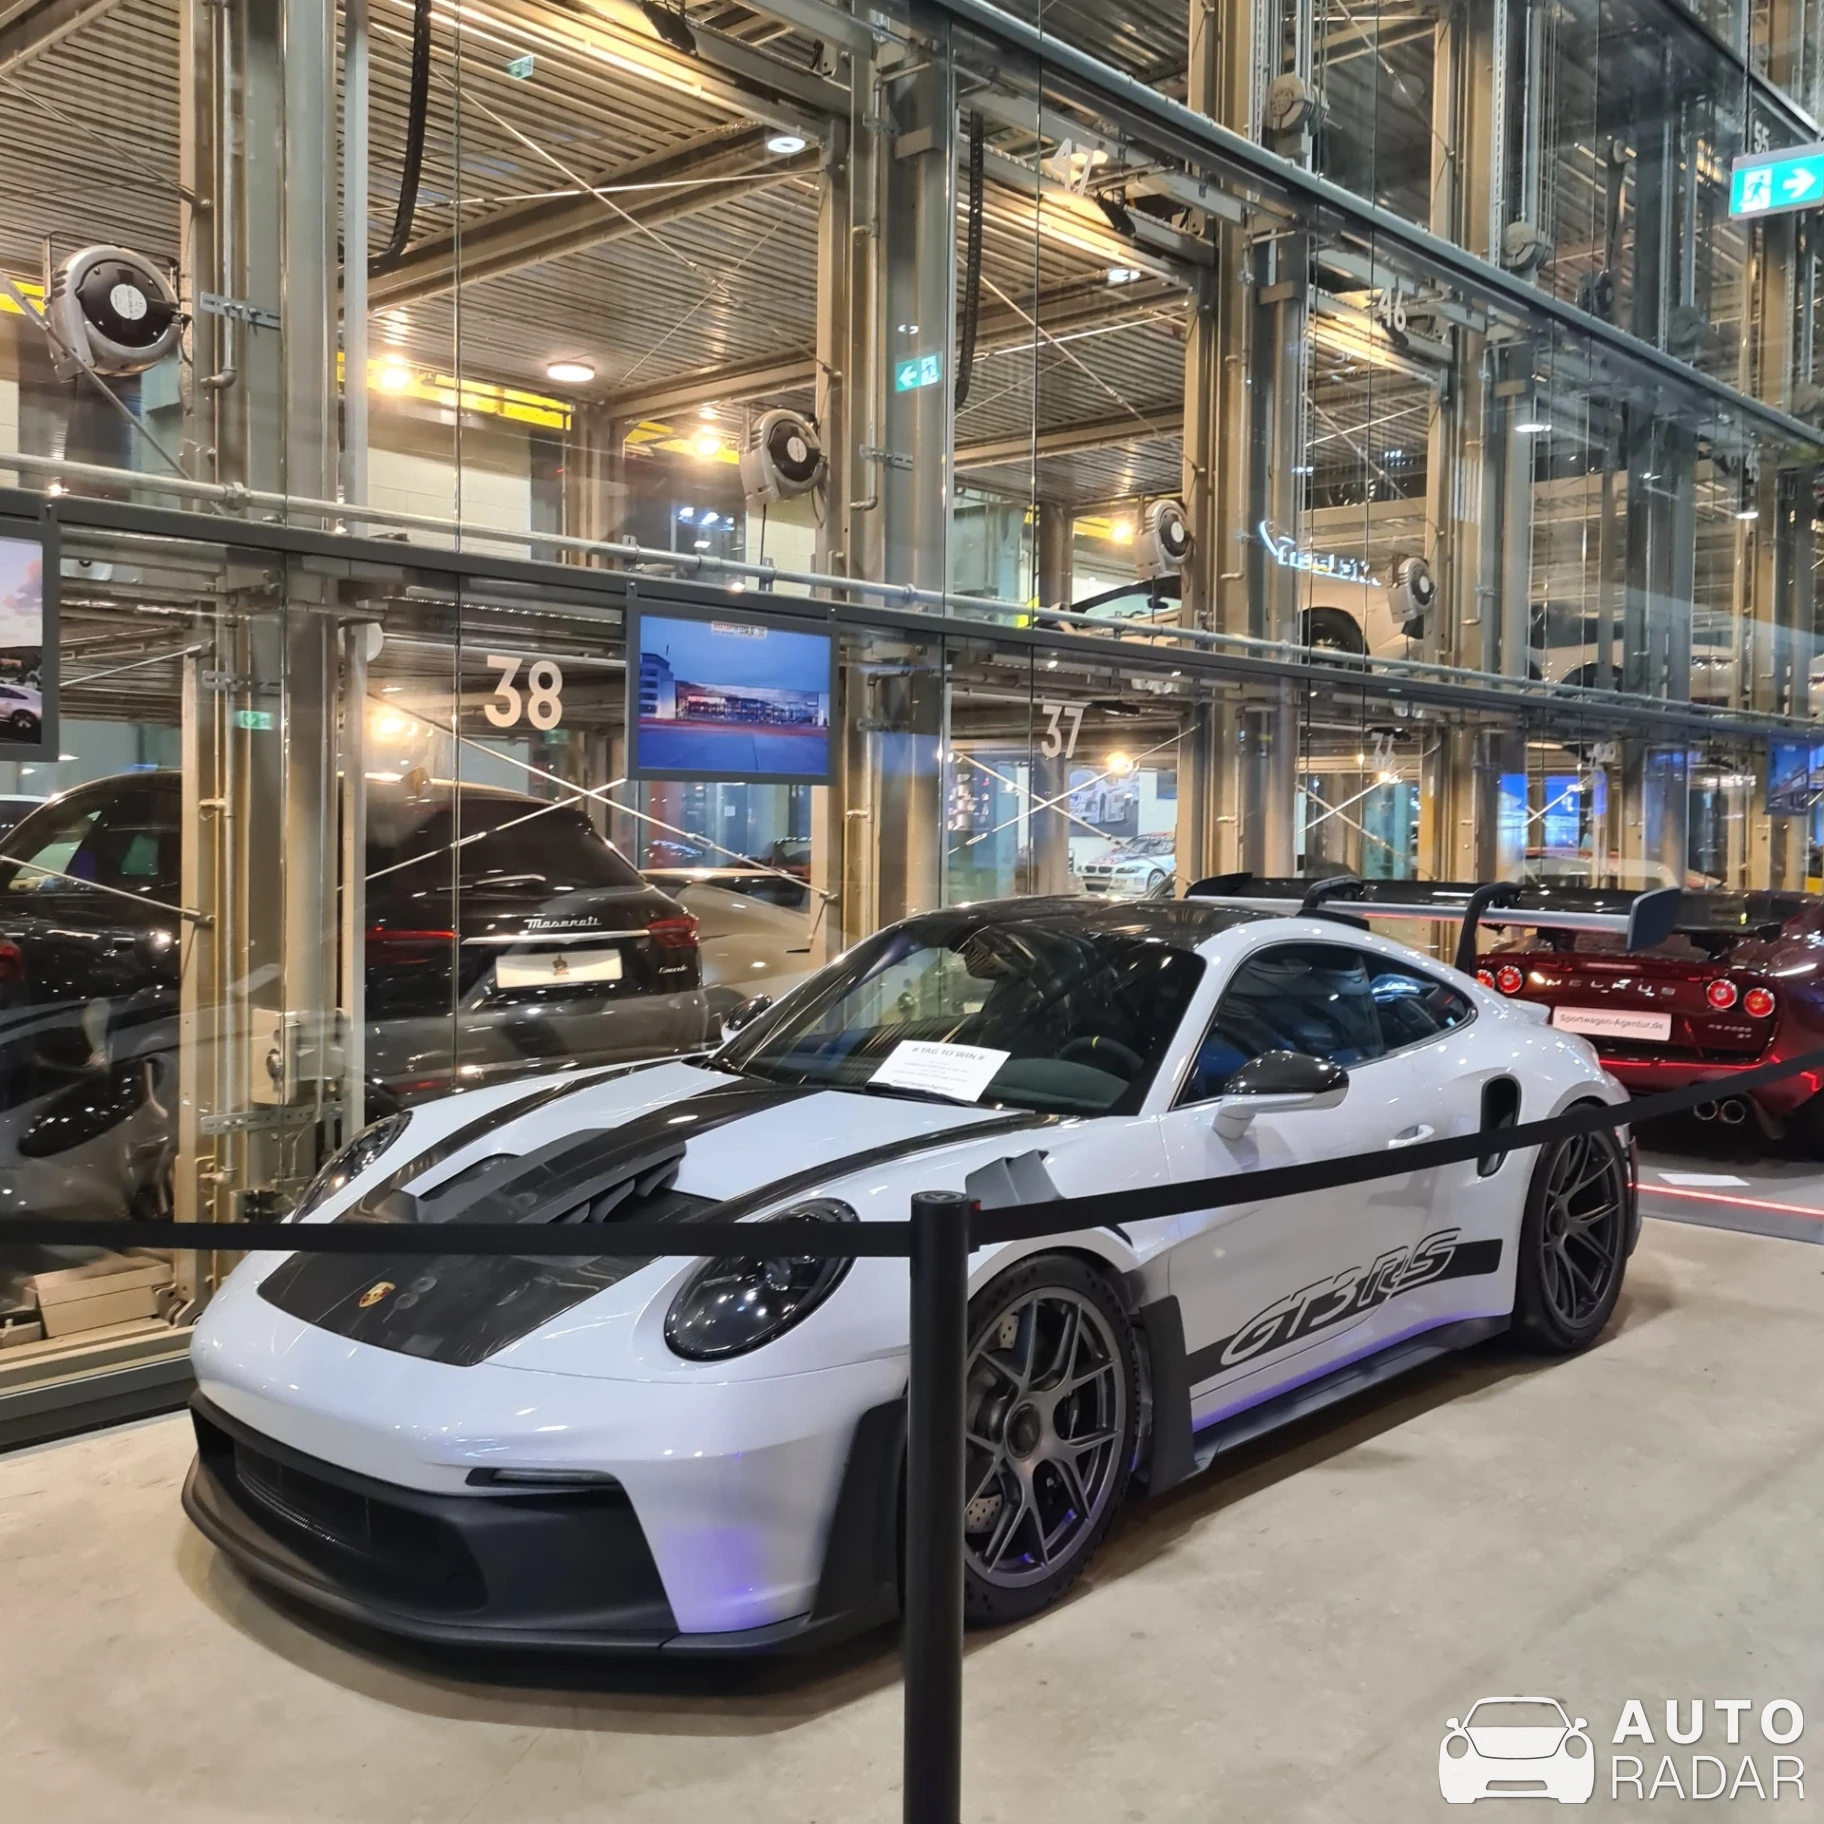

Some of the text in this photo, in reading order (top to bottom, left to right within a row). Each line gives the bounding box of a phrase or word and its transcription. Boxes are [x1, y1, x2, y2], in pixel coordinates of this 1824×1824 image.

[1051, 138, 1094, 197] 47
[1379, 285, 1407, 332] 46
[484, 655, 563, 731] 38
[1041, 704, 1084, 759] 37
[523, 916, 602, 930] Maserati
[1560, 1013, 1664, 1030] Sportwagen-Agentur.de
[920, 1047, 938, 1055] TAG
[941, 1049, 954, 1057] TO
[956, 1051, 977, 1060] WIN
